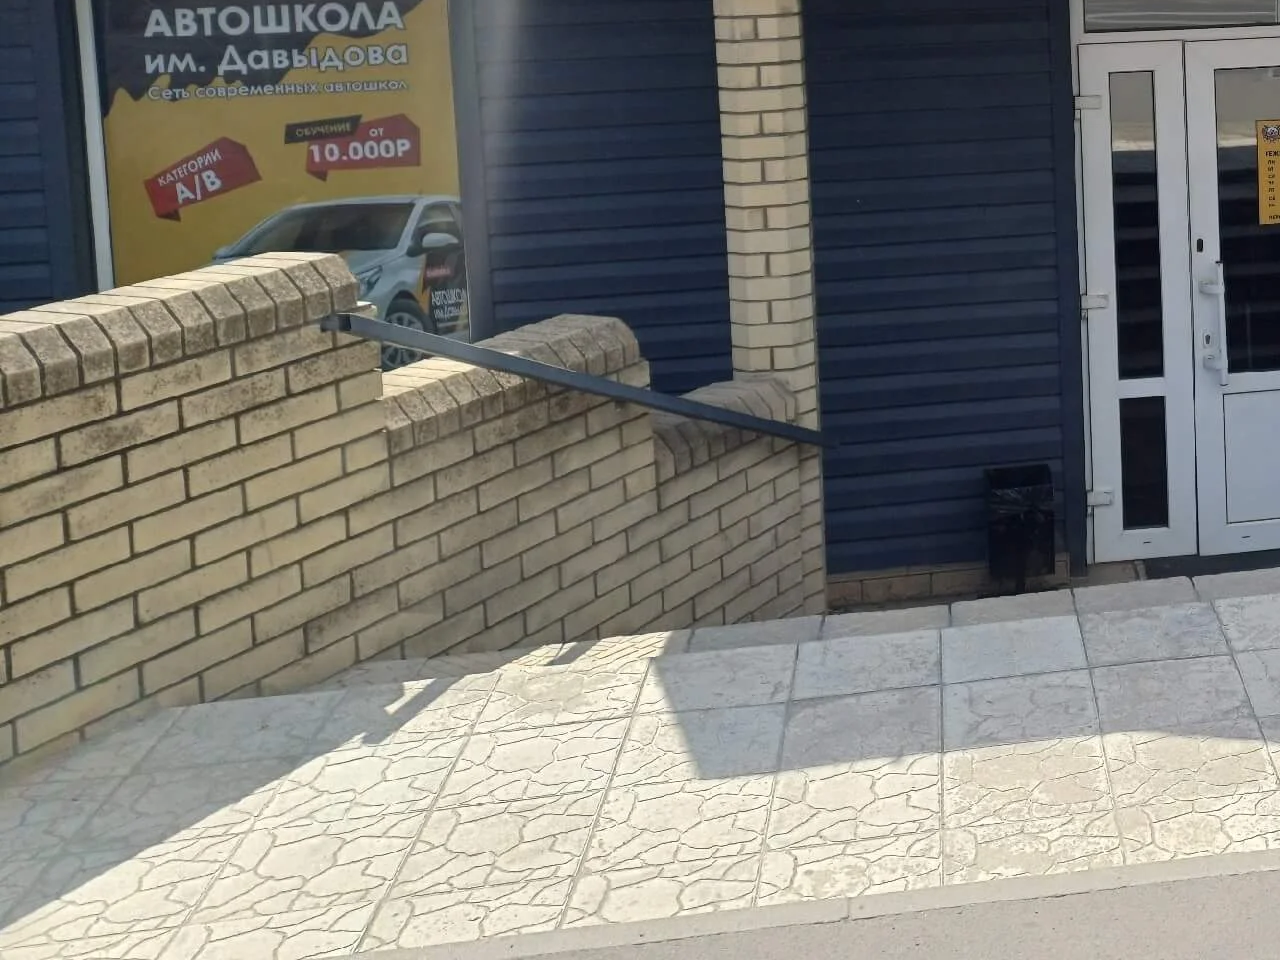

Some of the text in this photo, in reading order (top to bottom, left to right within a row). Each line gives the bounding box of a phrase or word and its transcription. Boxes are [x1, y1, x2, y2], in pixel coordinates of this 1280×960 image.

[144, 1, 405, 38] АВТОШКОЛА
[144, 42, 409, 77] им. Давыдова
[147, 79, 408, 101] Сеть современных автошкол
[295, 122, 352, 137] ОБУЧЕНИЕ
[157, 149, 222, 186] КАТЕГОРИИ
